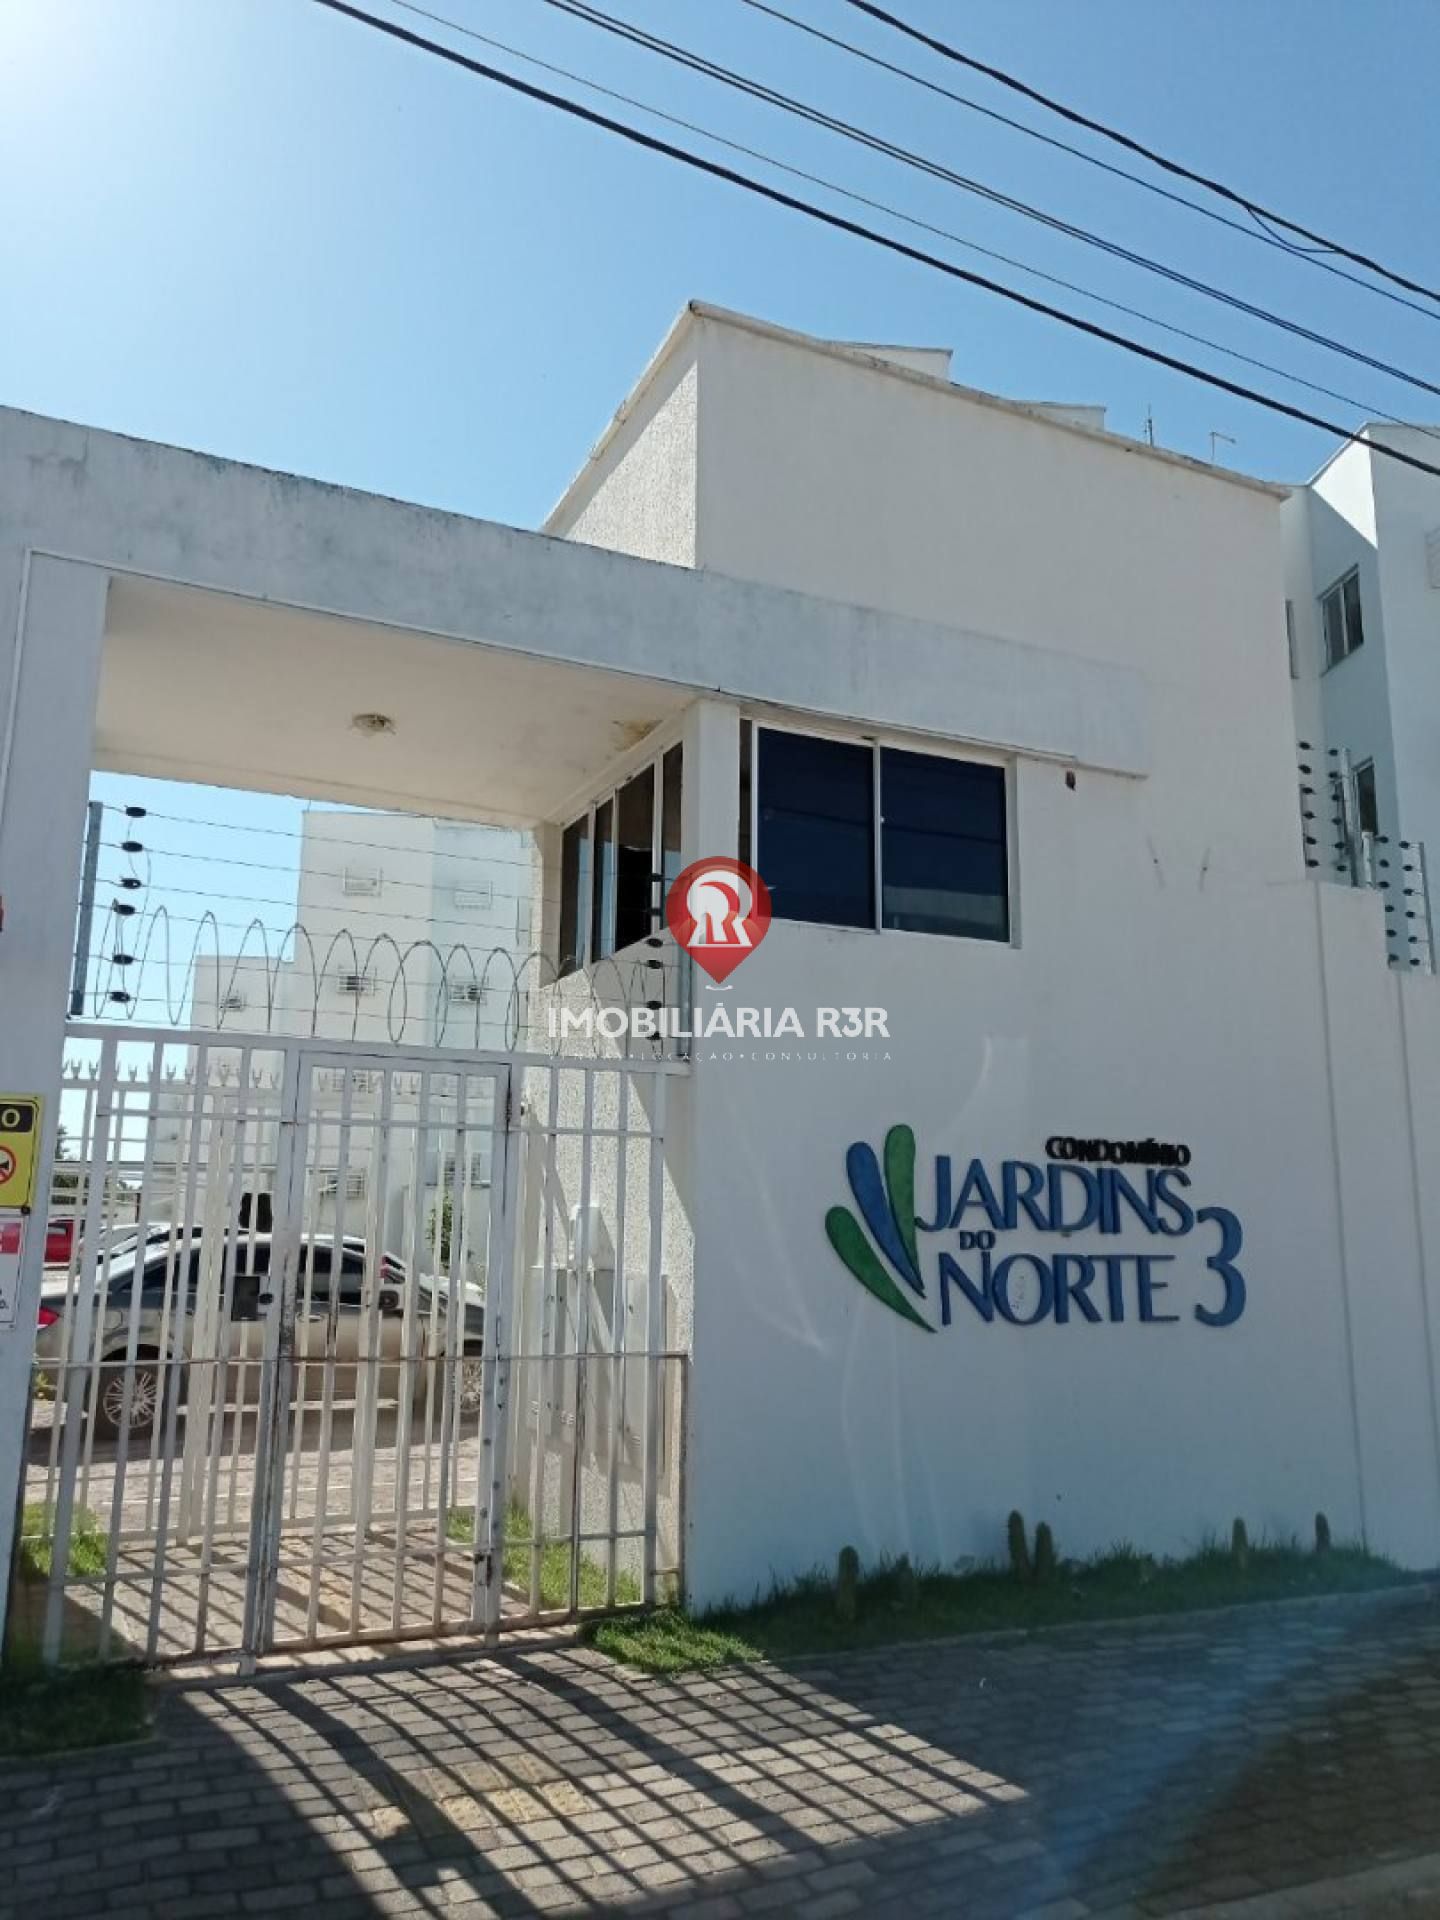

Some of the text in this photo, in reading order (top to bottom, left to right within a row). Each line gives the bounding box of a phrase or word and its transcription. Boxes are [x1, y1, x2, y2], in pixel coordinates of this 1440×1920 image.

[914, 1155, 1195, 1236] JARDINS
[938, 1206, 1246, 1327] NORTE 3
[960, 1230, 996, 1250] DO
